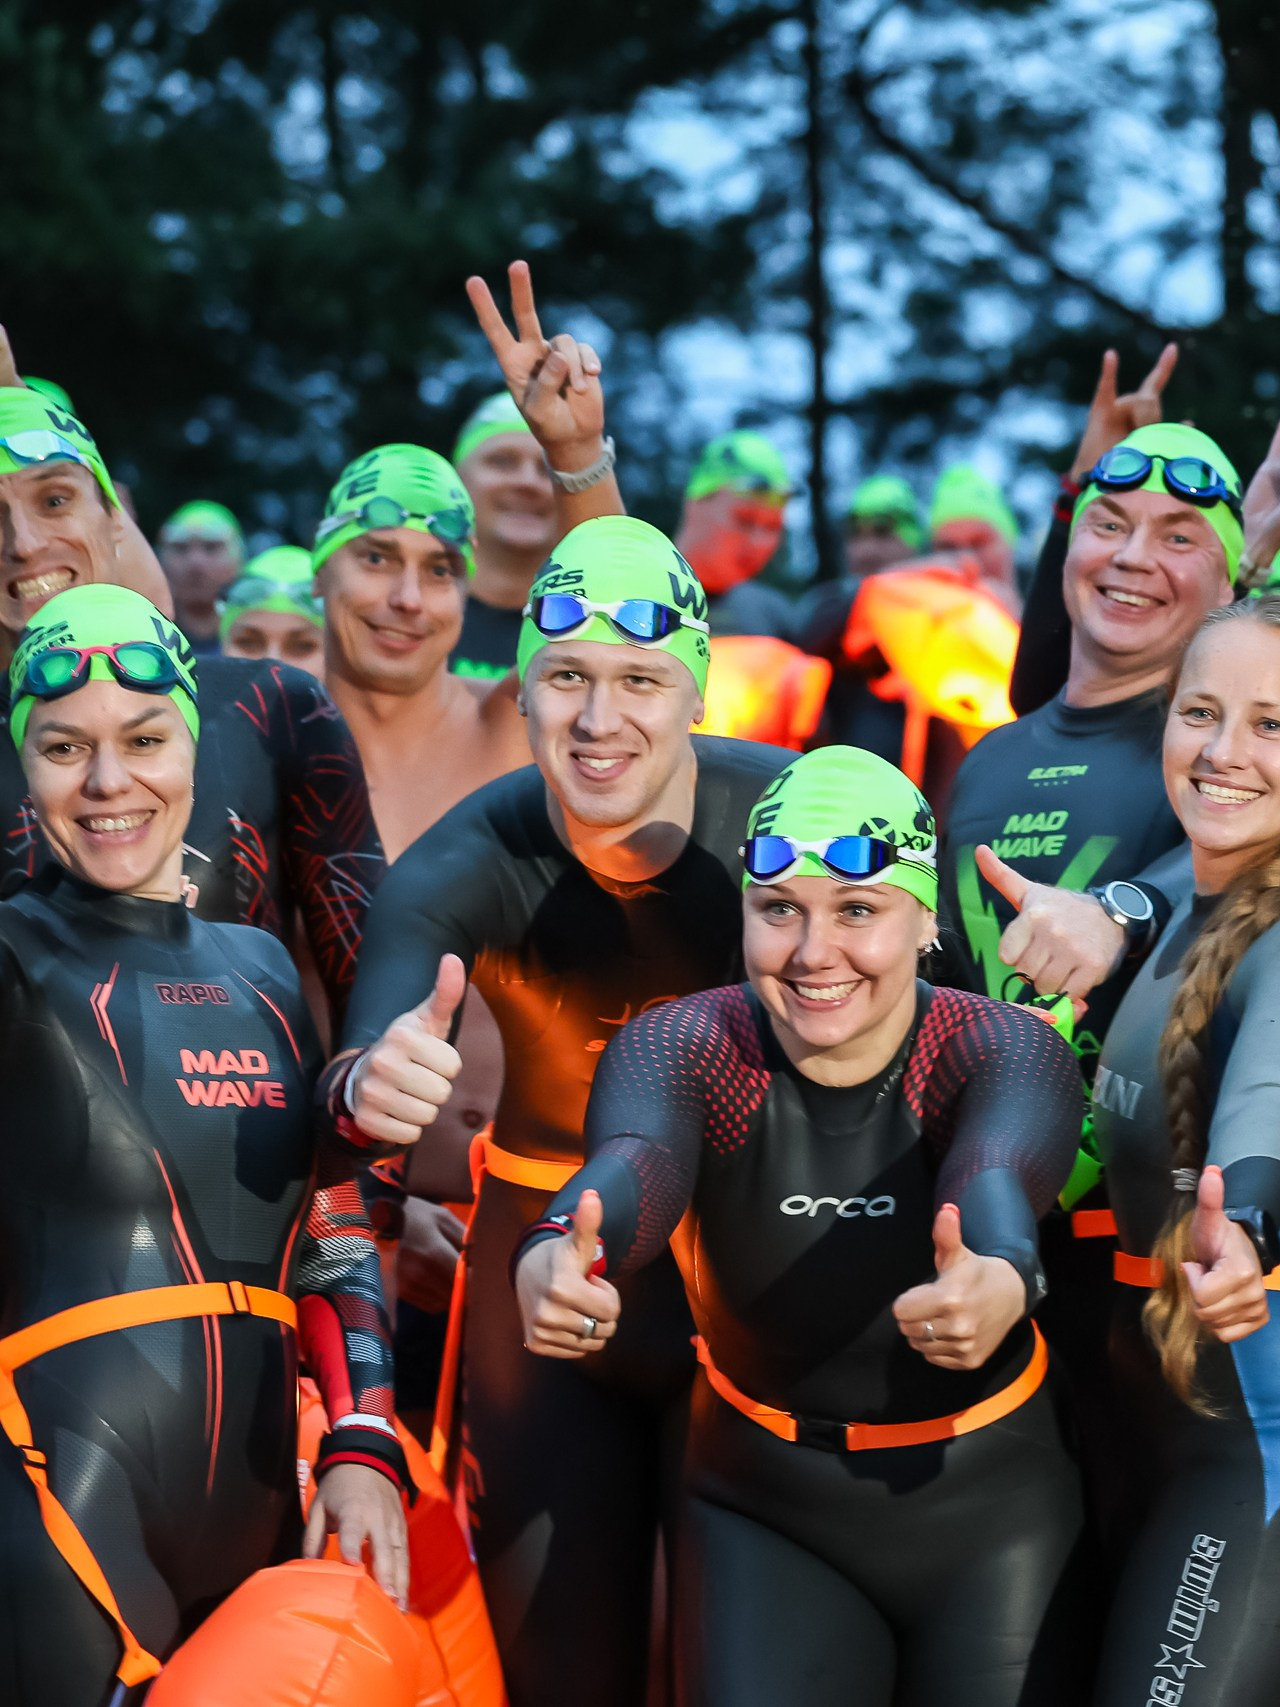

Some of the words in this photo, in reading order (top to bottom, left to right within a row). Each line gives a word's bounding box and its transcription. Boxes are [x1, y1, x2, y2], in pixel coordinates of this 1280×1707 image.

[1002, 809, 1069, 835] MAD
[991, 833, 1068, 859] WAVE
[153, 982, 233, 1005] RAPID
[179, 1047, 270, 1076] MAD
[175, 1077, 288, 1109] WAVE
[779, 1194, 897, 1219] orca
